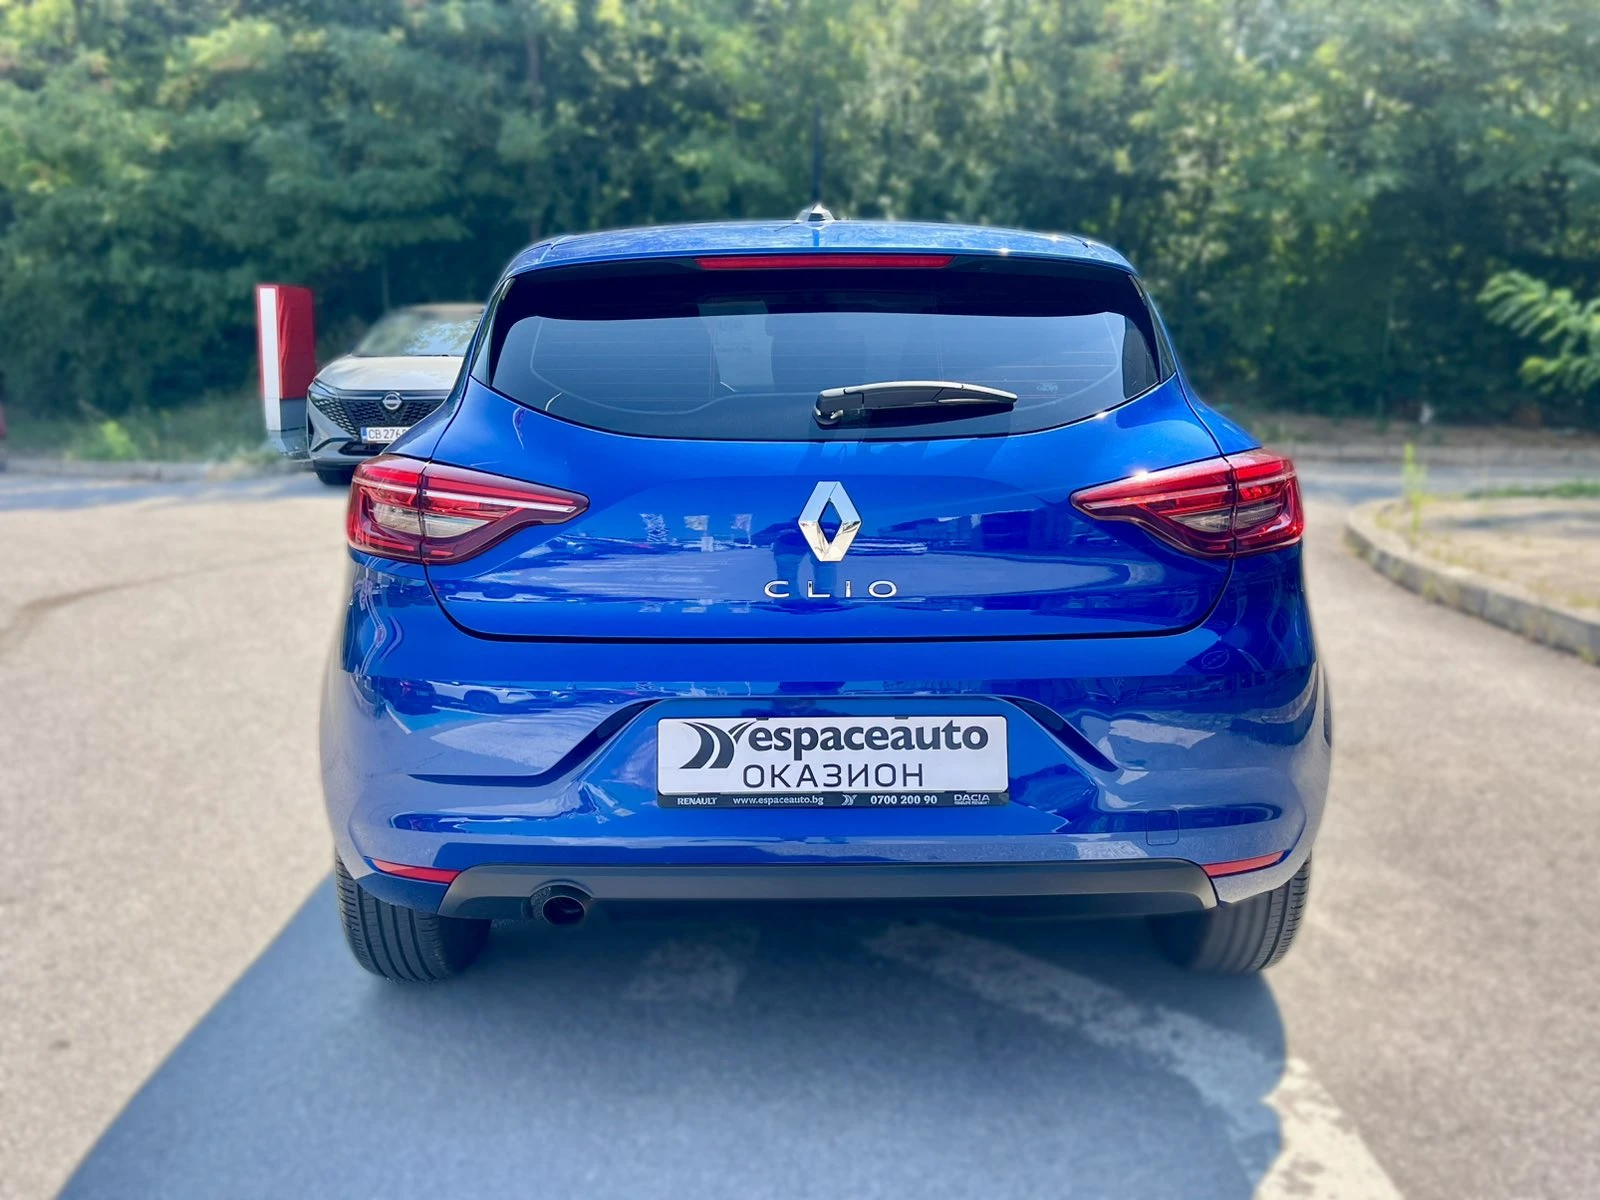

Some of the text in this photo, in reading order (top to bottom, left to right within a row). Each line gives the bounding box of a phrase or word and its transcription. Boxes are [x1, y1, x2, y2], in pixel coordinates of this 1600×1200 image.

[368, 429, 407, 439] CB 276
[764, 580, 897, 598] CLIO
[749, 720, 989, 761] espaceauto
[743, 763, 923, 788] ОКАЗИОН
[677, 797, 717, 805] RENAULT
[732, 795, 824, 806] www.espaceauto.bg
[870, 795, 938, 805] 0700 200 90
